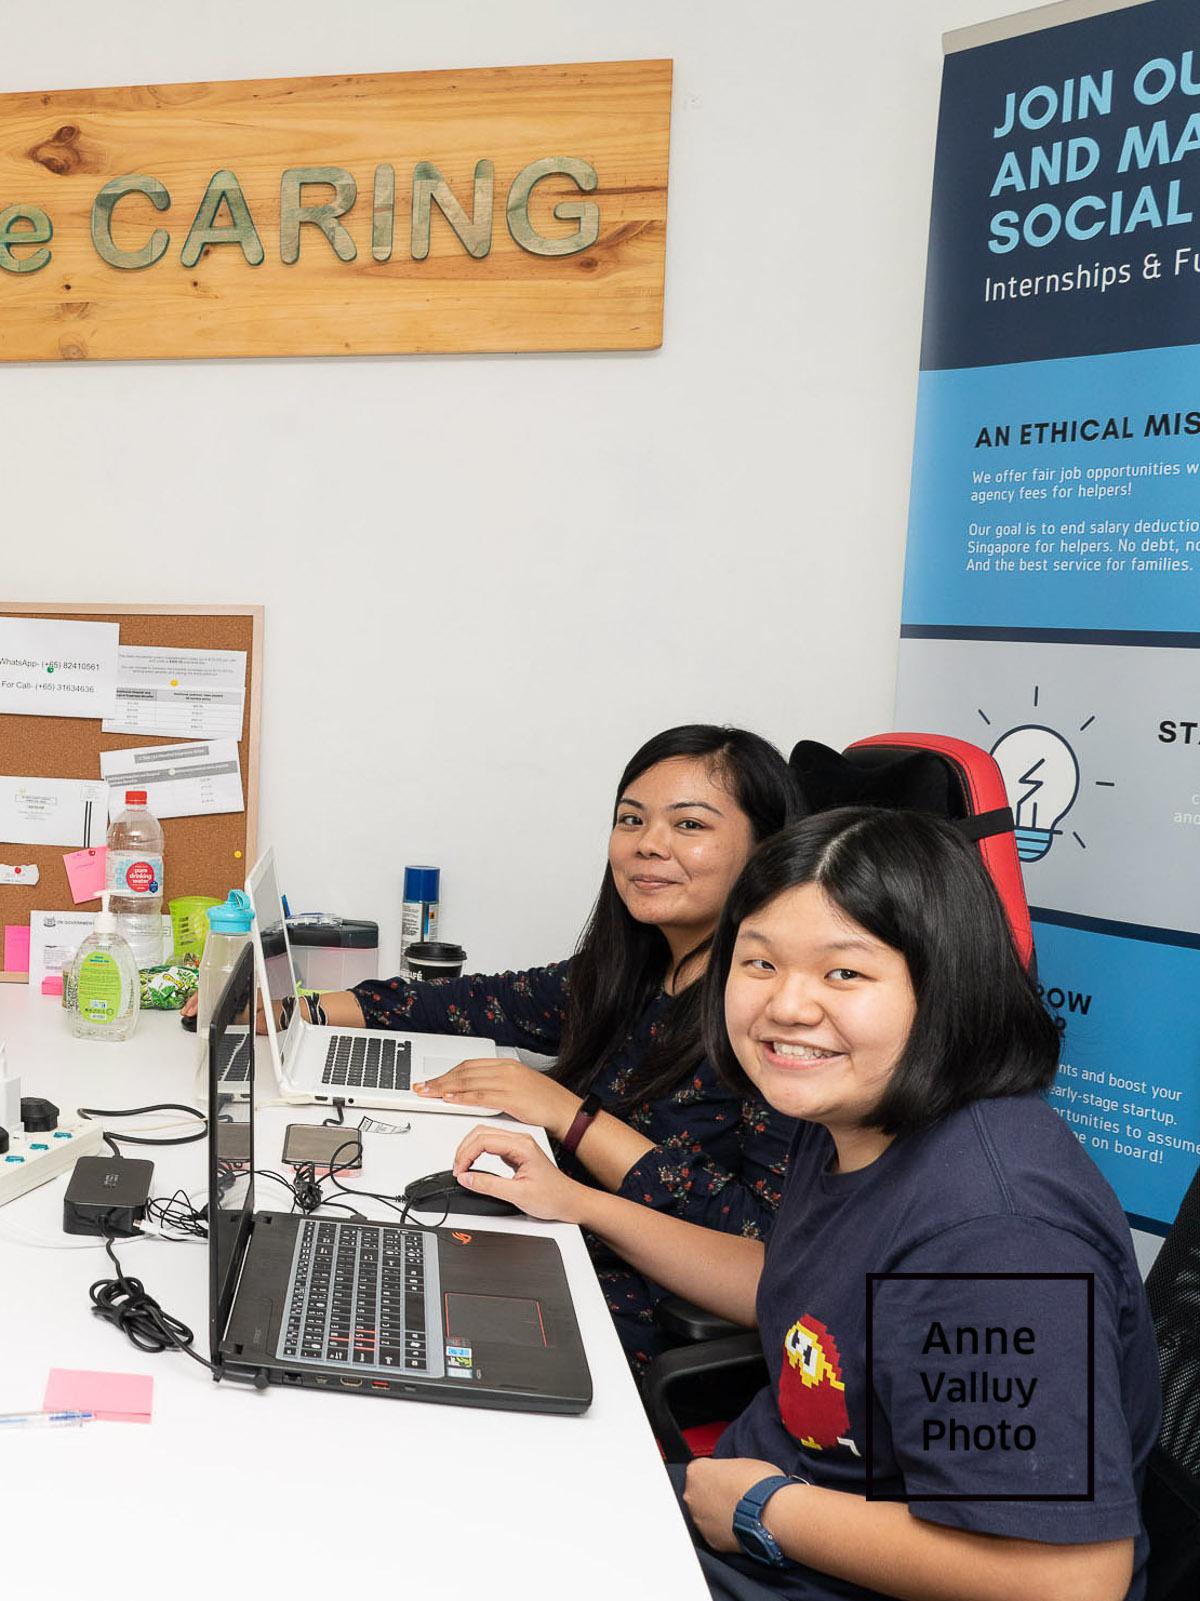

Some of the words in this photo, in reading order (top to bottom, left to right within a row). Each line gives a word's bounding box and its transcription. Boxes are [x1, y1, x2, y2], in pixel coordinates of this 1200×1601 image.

[993, 69, 1114, 139] JOIN
[1133, 50, 1200, 106] OU
[989, 136, 1101, 198] AND
[1117, 112, 1200, 174] MA
[90, 155, 600, 270] CARING
[987, 179, 1193, 254] SOCIAL
[985, 262, 1131, 302] Internships
[1142, 252, 1161, 280] &
[975, 425, 1011, 449] AN
[1020, 416, 1134, 445] ETHICAL
[1144, 411, 1200, 437] MIS
[972, 470, 991, 484] We
[995, 469, 1026, 483] offer
[1032, 468, 1054, 481] fair
[1060, 466, 1082, 483] job
[1086, 462, 1181, 482] opportunities
[970, 488, 1015, 504] agency
[1019, 486, 1047, 500] fees
[1052, 485, 1073, 498] for
[1078, 482, 1132, 500] helpers!
[969, 523, 991, 536] Our
[995, 521, 1021, 539] goal
[1025, 521, 1036, 535] is
[1041, 521, 1055, 535] to
[1060, 520, 1085, 535] end
[1090, 519, 1130, 537] salary
[967, 541, 1031, 558] Singapore
[1035, 540, 1055, 554] for
[1060, 539, 1113, 556] helpers.
[1118, 539, 1136, 553] No
[1141, 538, 1180, 555] debt,
[966, 559, 990, 572] And
[995, 558, 1015, 572] the
[1019, 558, 1048, 572] best
[1053, 557, 1101, 572] service
[1106, 557, 1126, 571] for
[1131, 557, 1193, 572] families.
[2, 680, 14, 688] For
[1158, 720, 1200, 745] ST
[1081, 1068, 1105, 1084] and
[1108, 1072, 1147, 1094] boost
[1151, 1085, 1183, 1102] your
[1123, 1102, 1178, 1127] startup.
[1091, 1136, 1109, 1150] on
[1114, 1139, 1164, 1165] board!
[1126, 1123, 1142, 1139] to
[1147, 1131, 1200, 1155] assume
